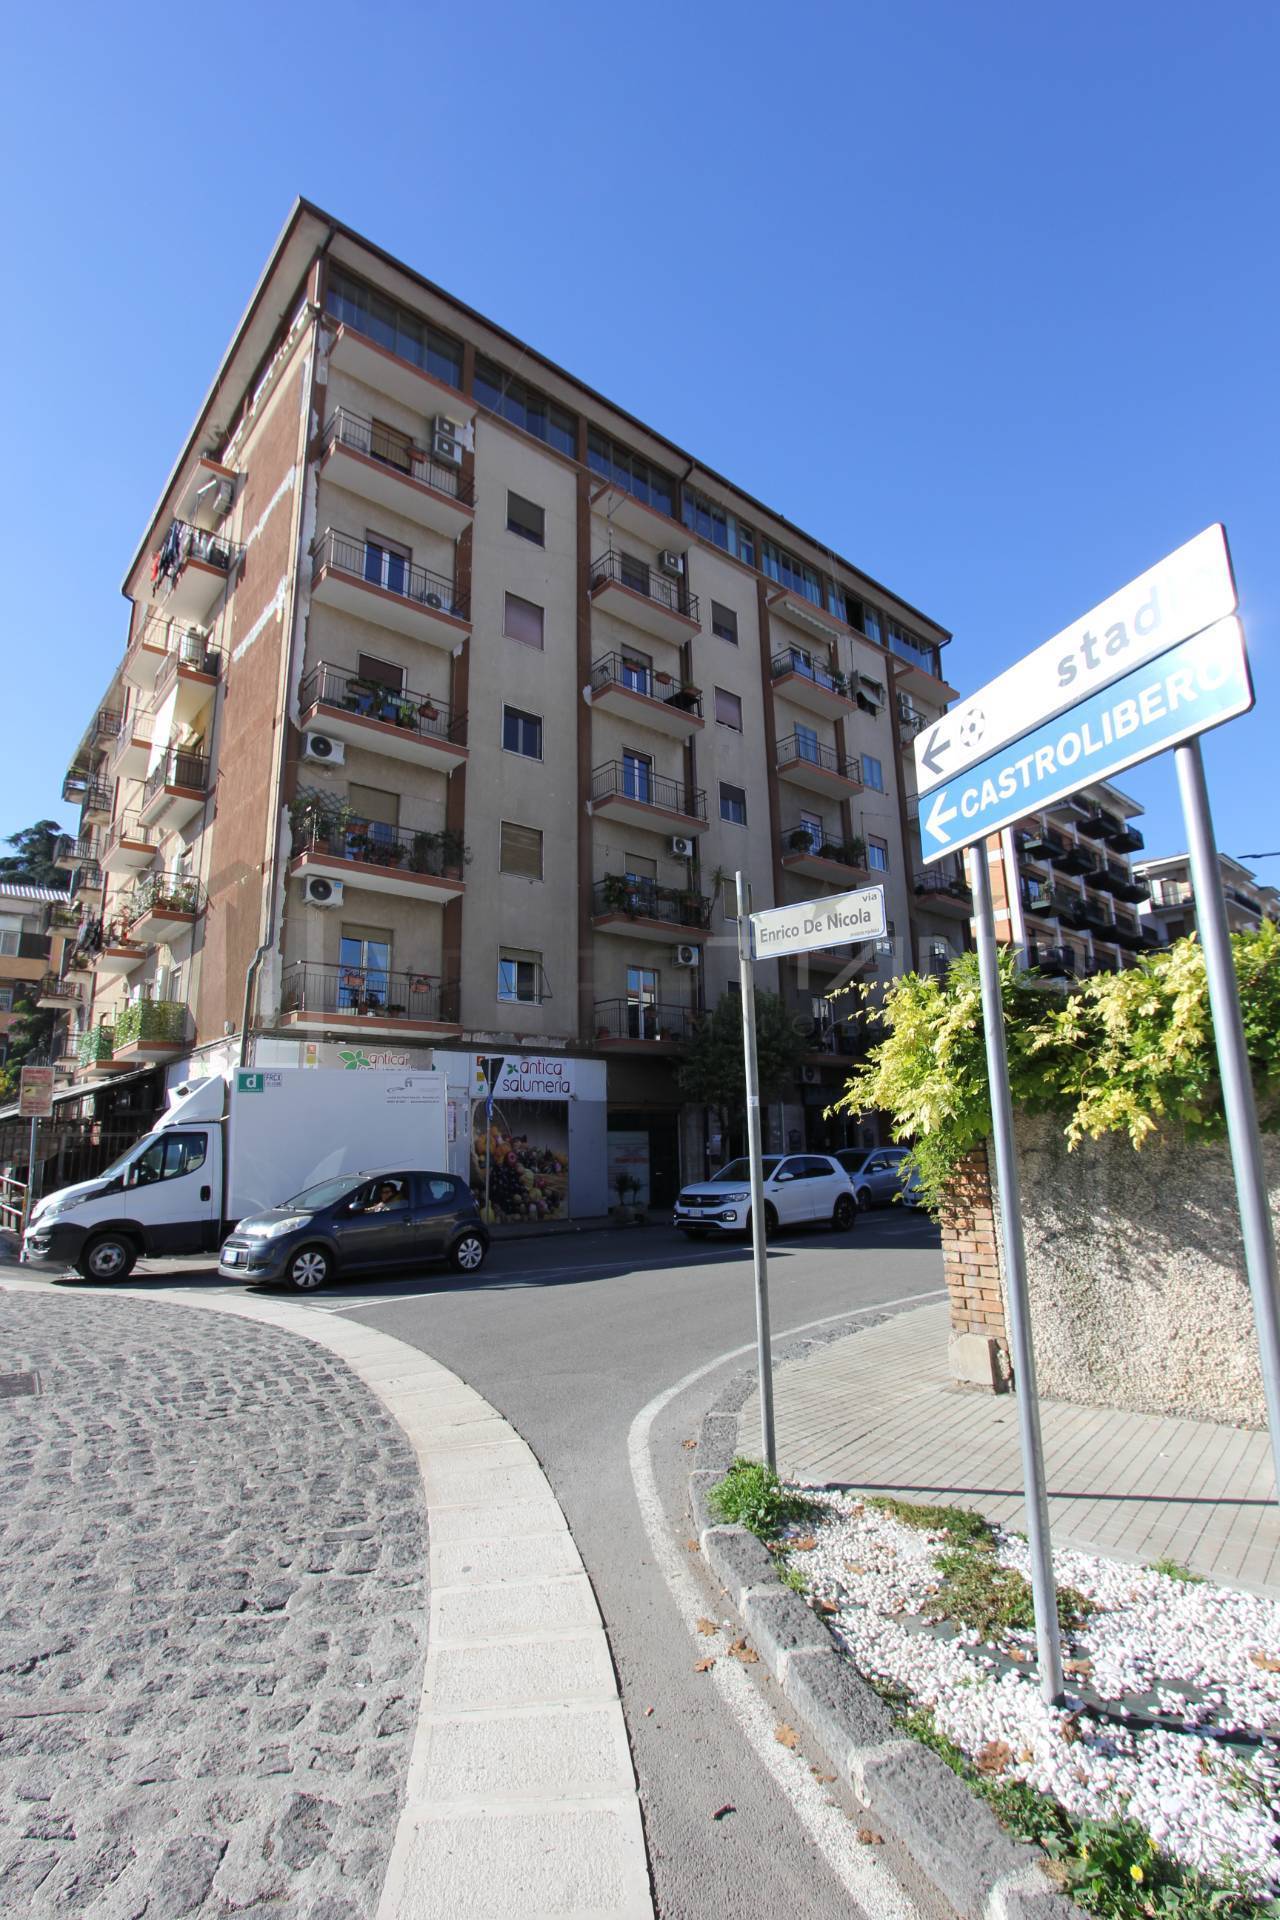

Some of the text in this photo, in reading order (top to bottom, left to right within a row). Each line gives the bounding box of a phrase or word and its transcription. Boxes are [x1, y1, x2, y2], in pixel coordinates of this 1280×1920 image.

[1057, 577, 1180, 688] stad
[960, 655, 1233, 818] CASTROLIBERO
[861, 893, 878, 902] via
[760, 908, 871, 943] Enrico De Nicola
[520, 1058, 562, 1075] antica
[503, 1075, 570, 1093] salumeria
